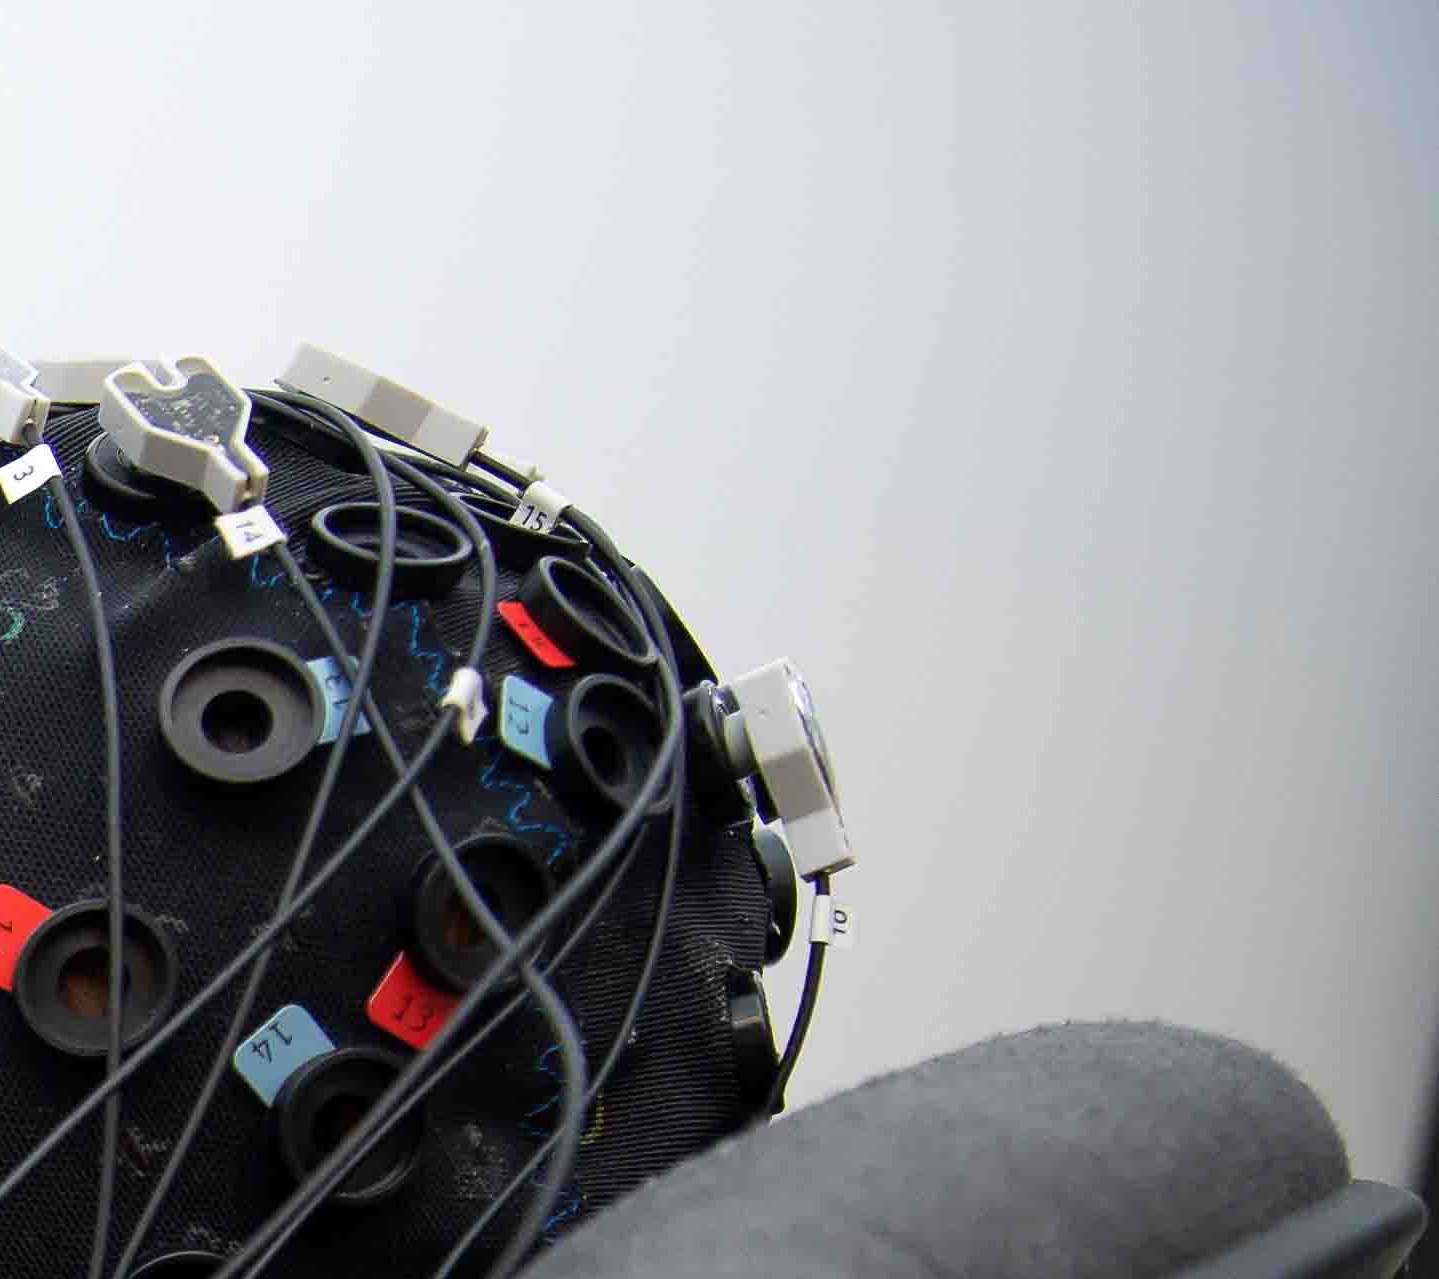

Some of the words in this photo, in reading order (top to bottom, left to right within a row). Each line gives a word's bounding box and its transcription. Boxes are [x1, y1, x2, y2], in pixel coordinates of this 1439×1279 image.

[12, 465, 35, 481] 3
[522, 504, 549, 531] 15
[507, 694, 531, 735] 12
[832, 909, 848, 936] 10
[391, 993, 438, 1033] 13
[250, 1021, 292, 1063] 14
